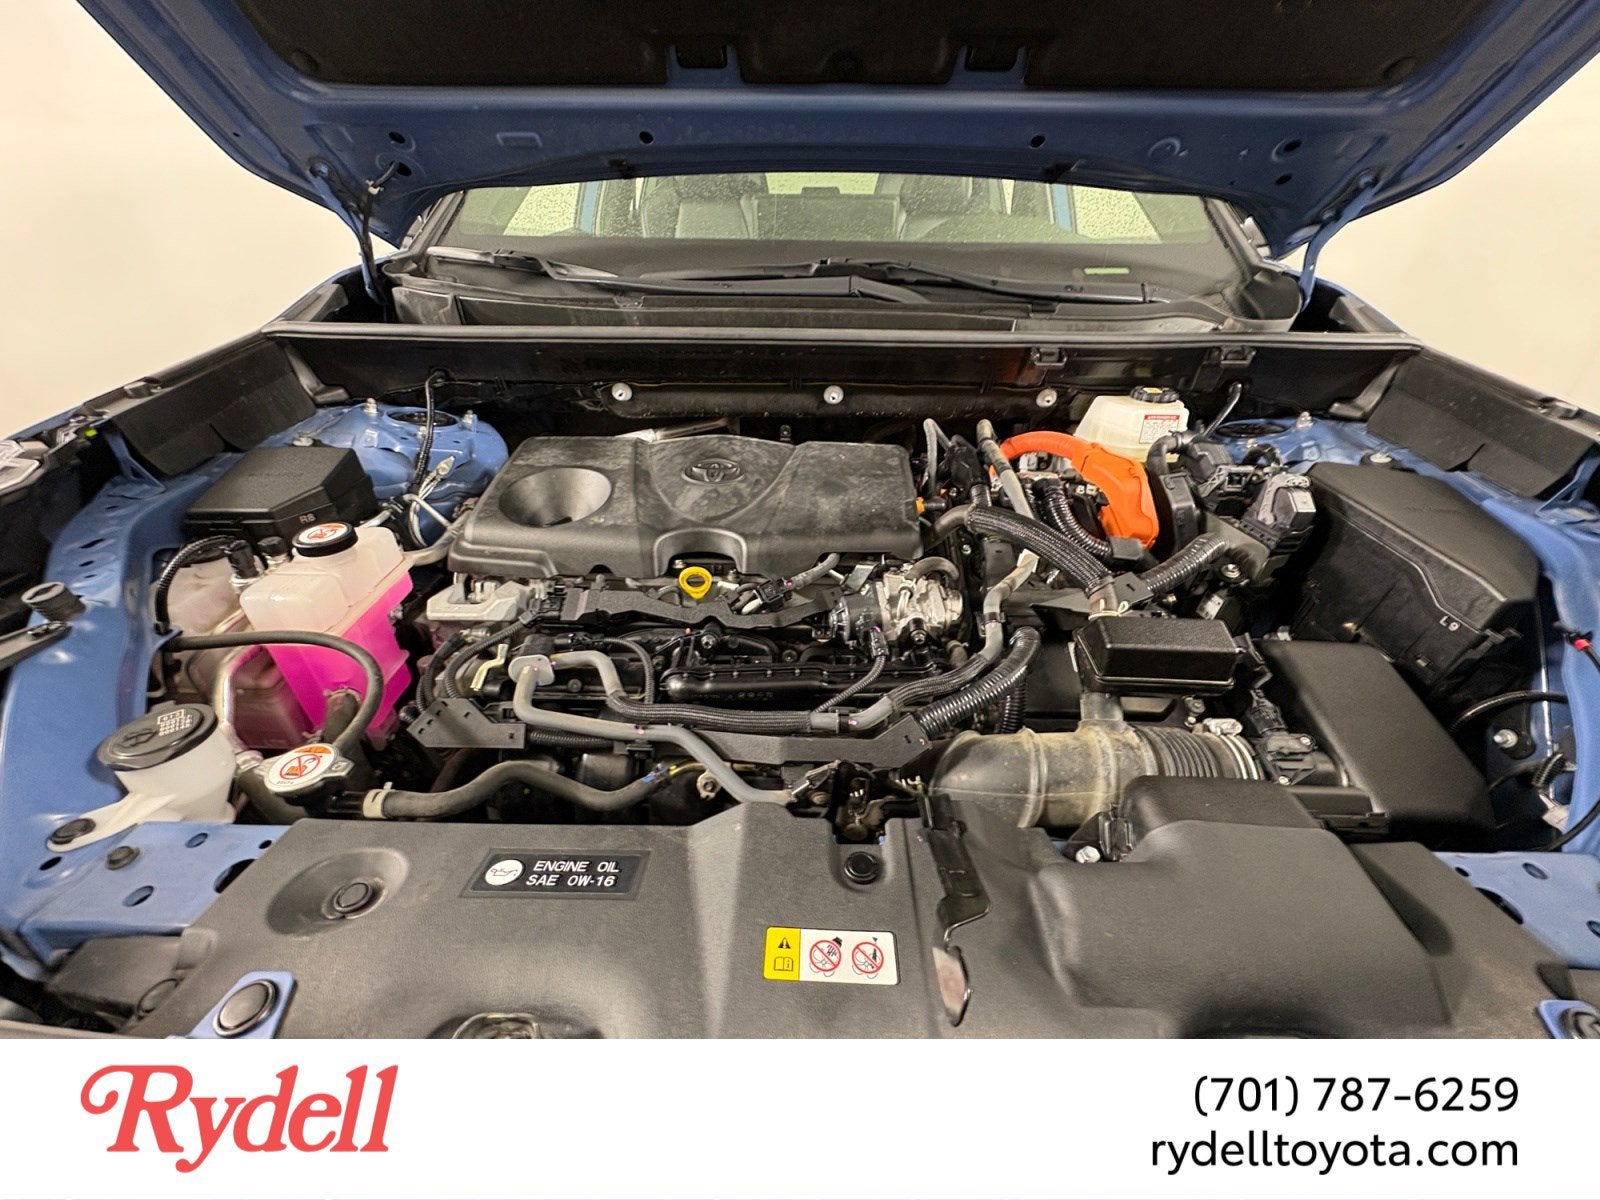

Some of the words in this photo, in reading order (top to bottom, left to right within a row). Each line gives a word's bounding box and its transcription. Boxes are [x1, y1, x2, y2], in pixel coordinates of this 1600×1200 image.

[533, 860, 590, 872] ENGINE
[597, 861, 621, 873] OIL
[526, 874, 559, 886] SAE
[567, 875, 615, 887] 0W-16
